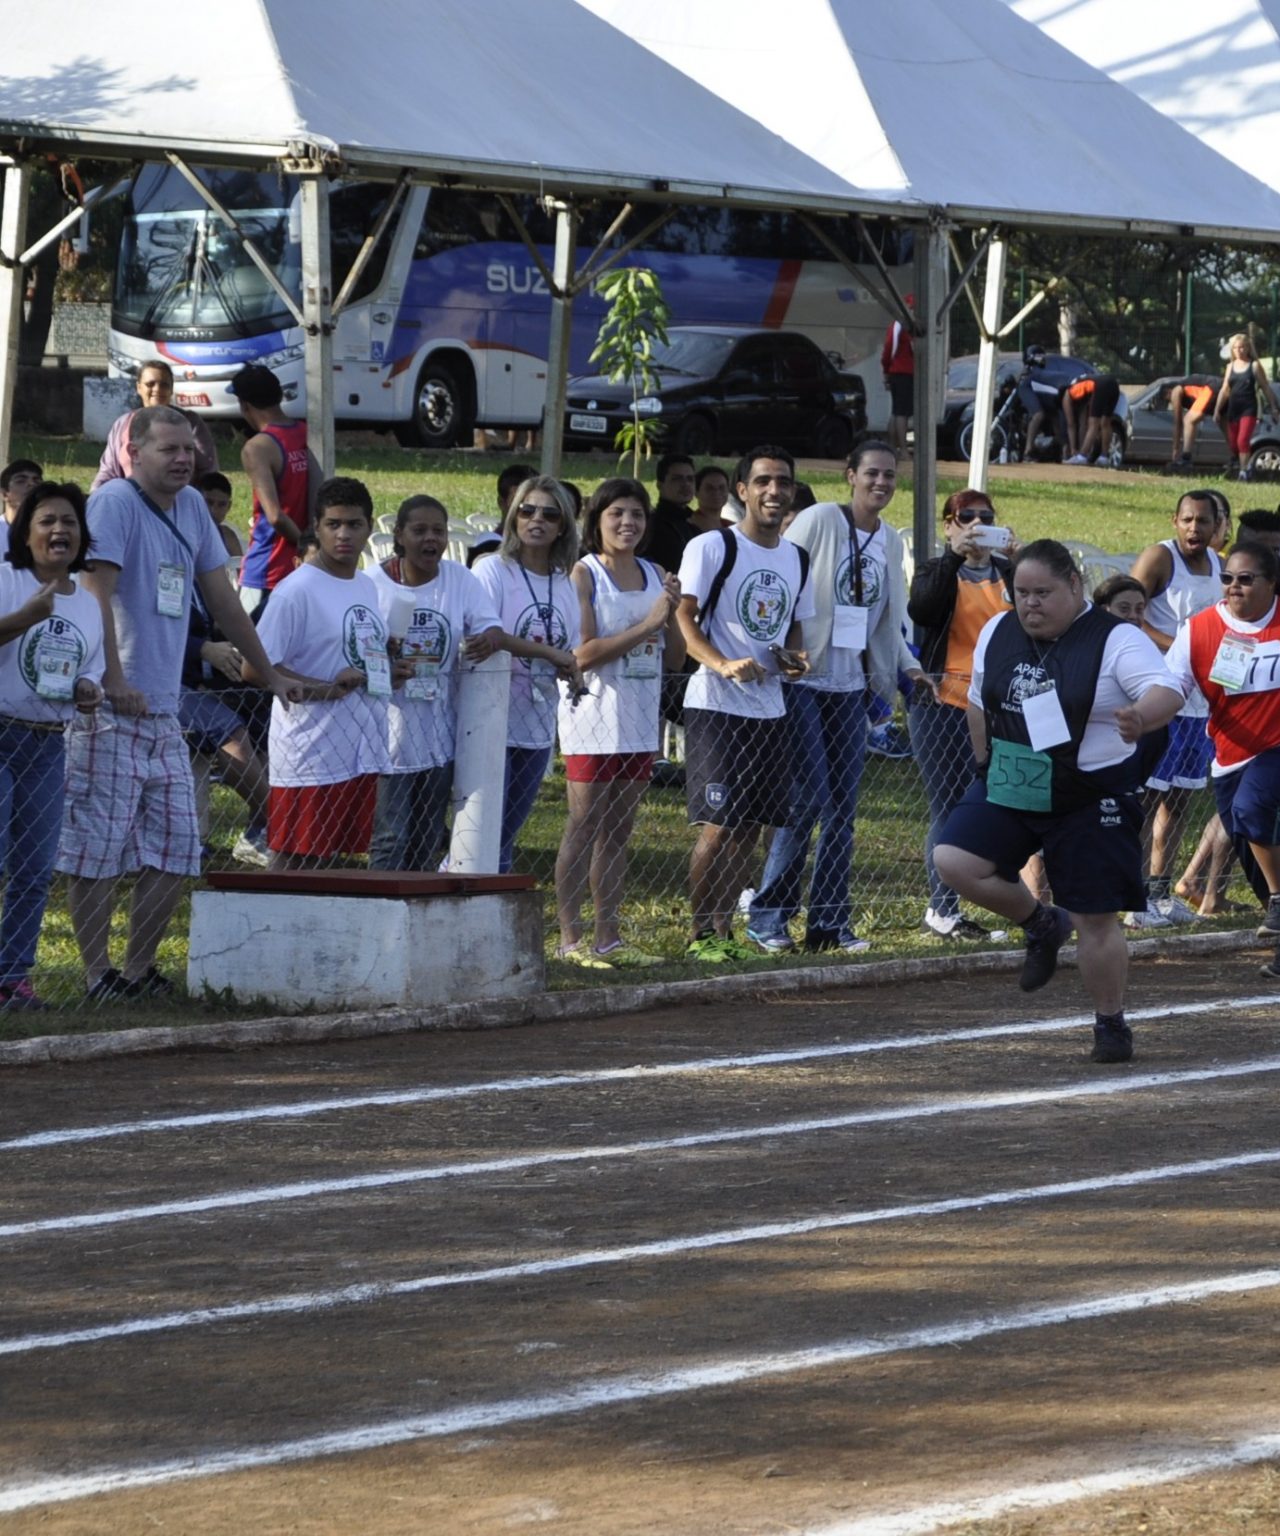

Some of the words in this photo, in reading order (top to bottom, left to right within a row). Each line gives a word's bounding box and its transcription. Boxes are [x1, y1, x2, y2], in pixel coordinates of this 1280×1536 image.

[1013, 662, 1046, 679] APAE
[993, 755, 1049, 790] 552
[1100, 815, 1122, 825] APAE
